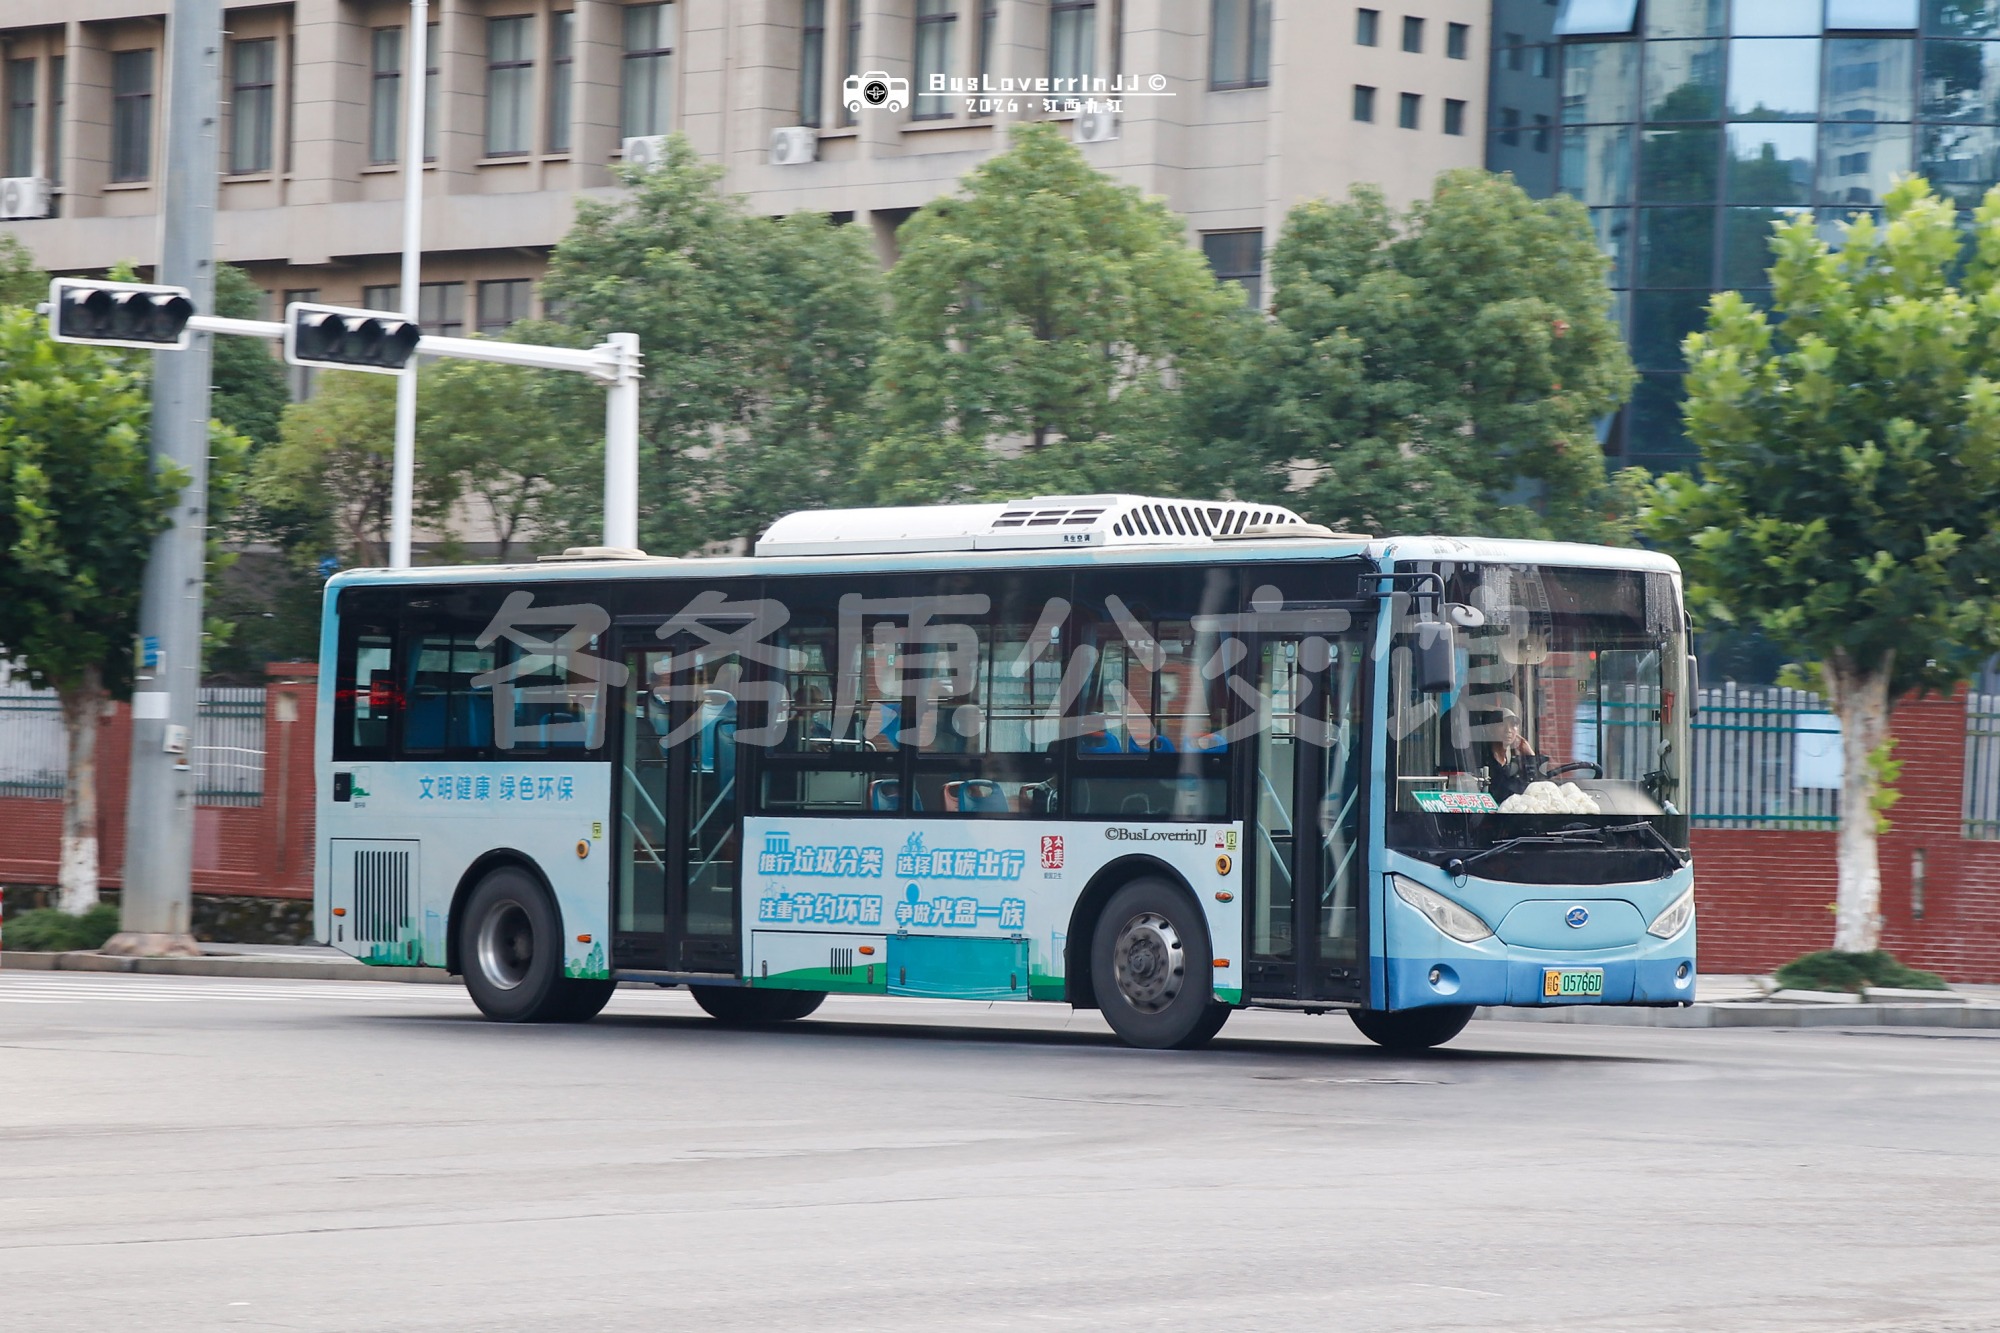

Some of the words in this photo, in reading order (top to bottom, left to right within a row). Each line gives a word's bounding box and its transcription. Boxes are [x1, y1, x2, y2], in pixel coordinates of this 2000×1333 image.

[418, 775, 491, 801] 文明健康
[499, 775, 574, 801] 绿色环保
[759, 846, 883, 878] 推行垃圾分类
[896, 849, 1025, 881] 选择低碳出行
[759, 892, 882, 924] 注重节约环保
[896, 897, 1025, 929] 争做光盘一族
[1564, 975, 1602, 992] 05766D
